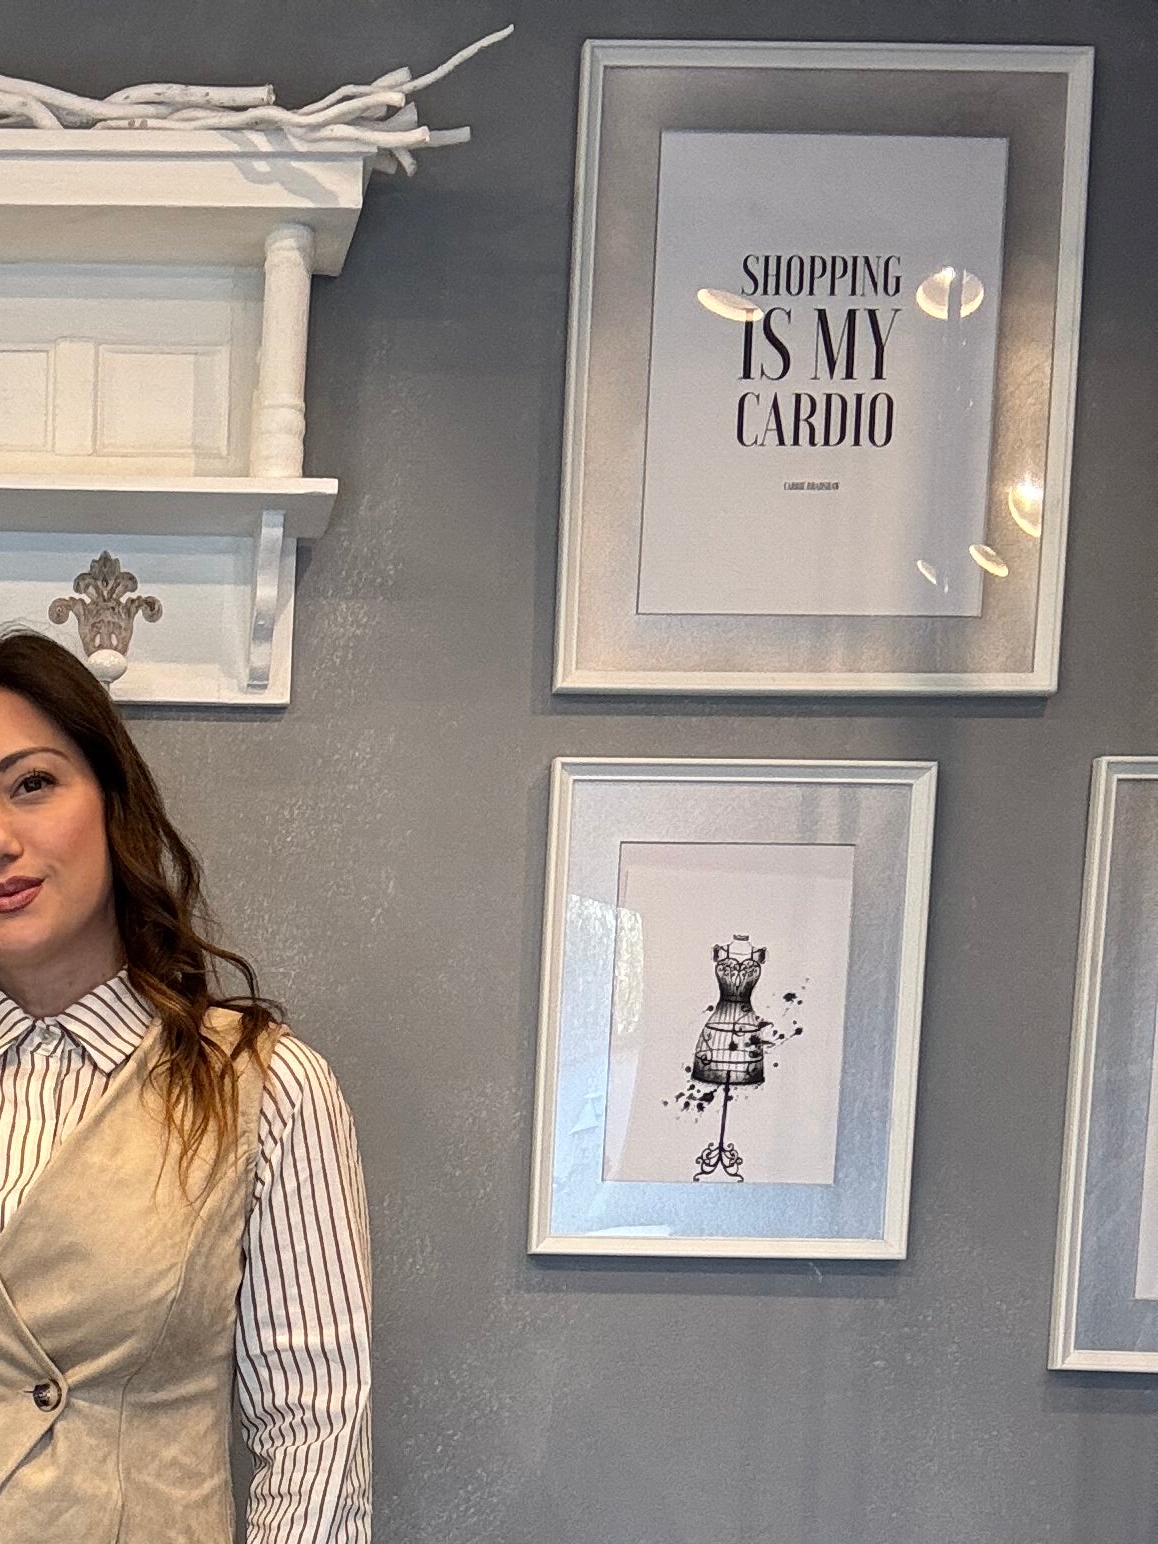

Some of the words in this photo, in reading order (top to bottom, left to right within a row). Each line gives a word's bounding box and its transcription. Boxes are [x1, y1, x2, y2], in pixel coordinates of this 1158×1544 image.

[741, 253, 902, 297] SHOPPING
[738, 306, 792, 381] IS
[810, 308, 903, 381] MY
[736, 391, 895, 448] CARDIO
